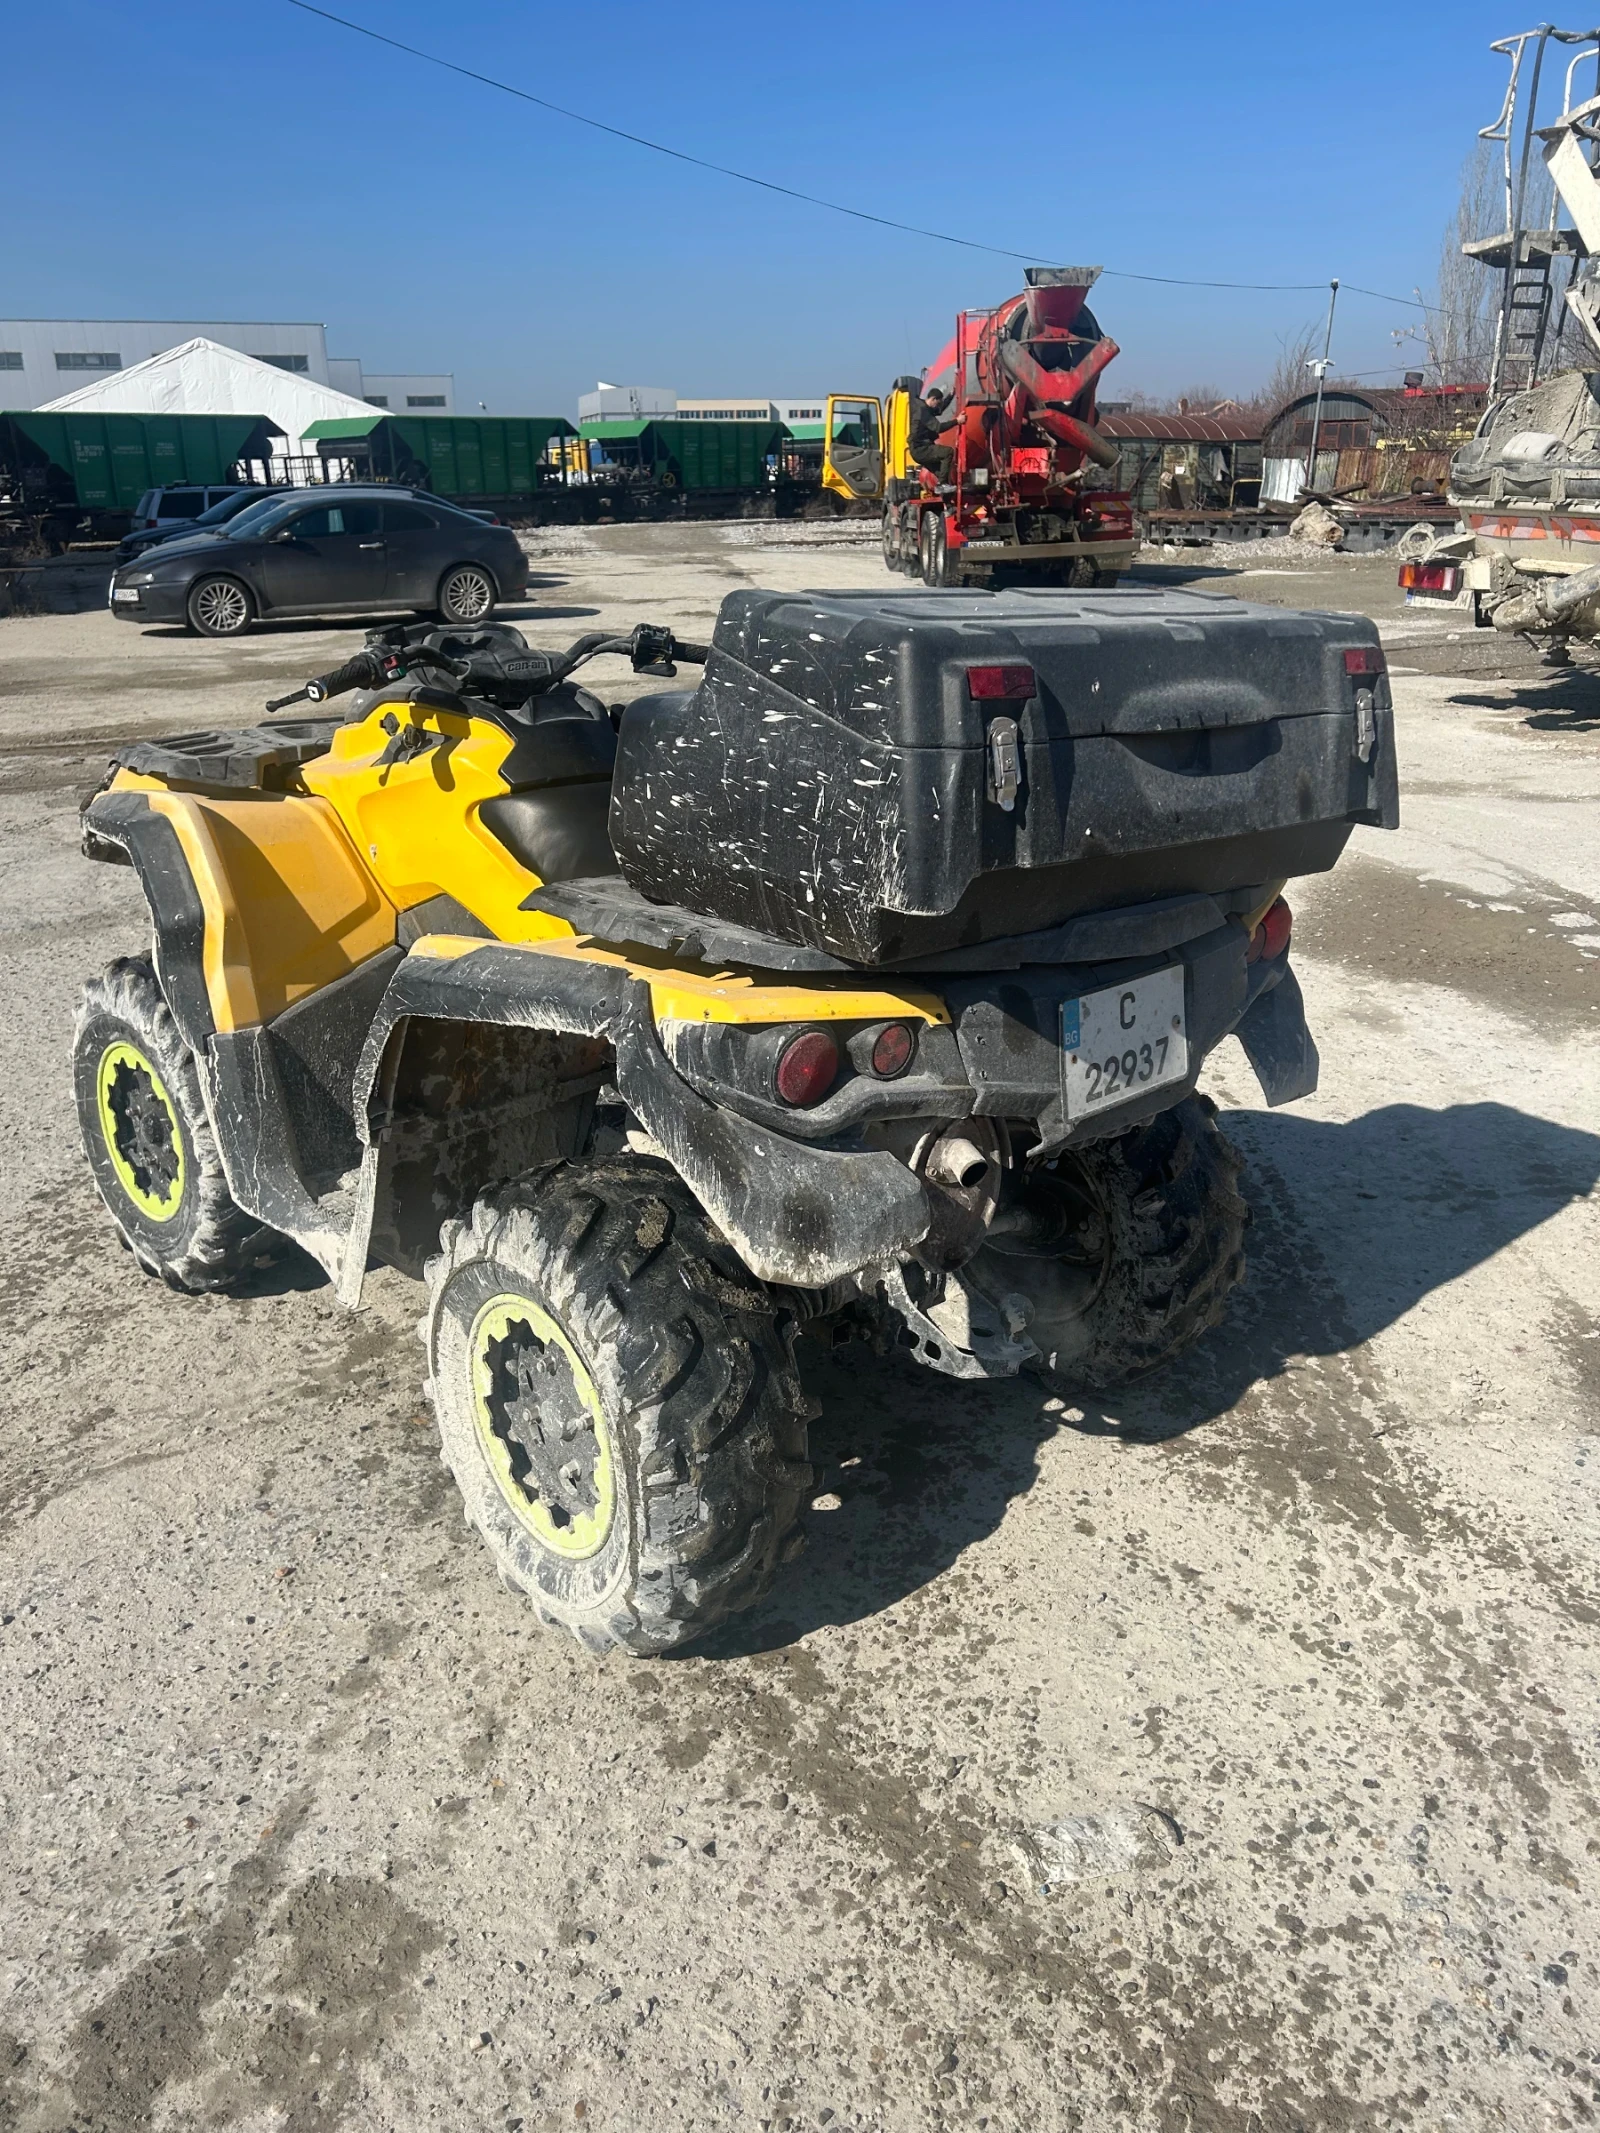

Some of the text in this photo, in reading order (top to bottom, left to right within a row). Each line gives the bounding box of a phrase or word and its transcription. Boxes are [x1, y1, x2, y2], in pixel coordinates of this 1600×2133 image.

[1119, 991, 1136, 1030] C
[1065, 1030, 1078, 1045] BG
[1085, 1036, 1169, 1103] 22937
